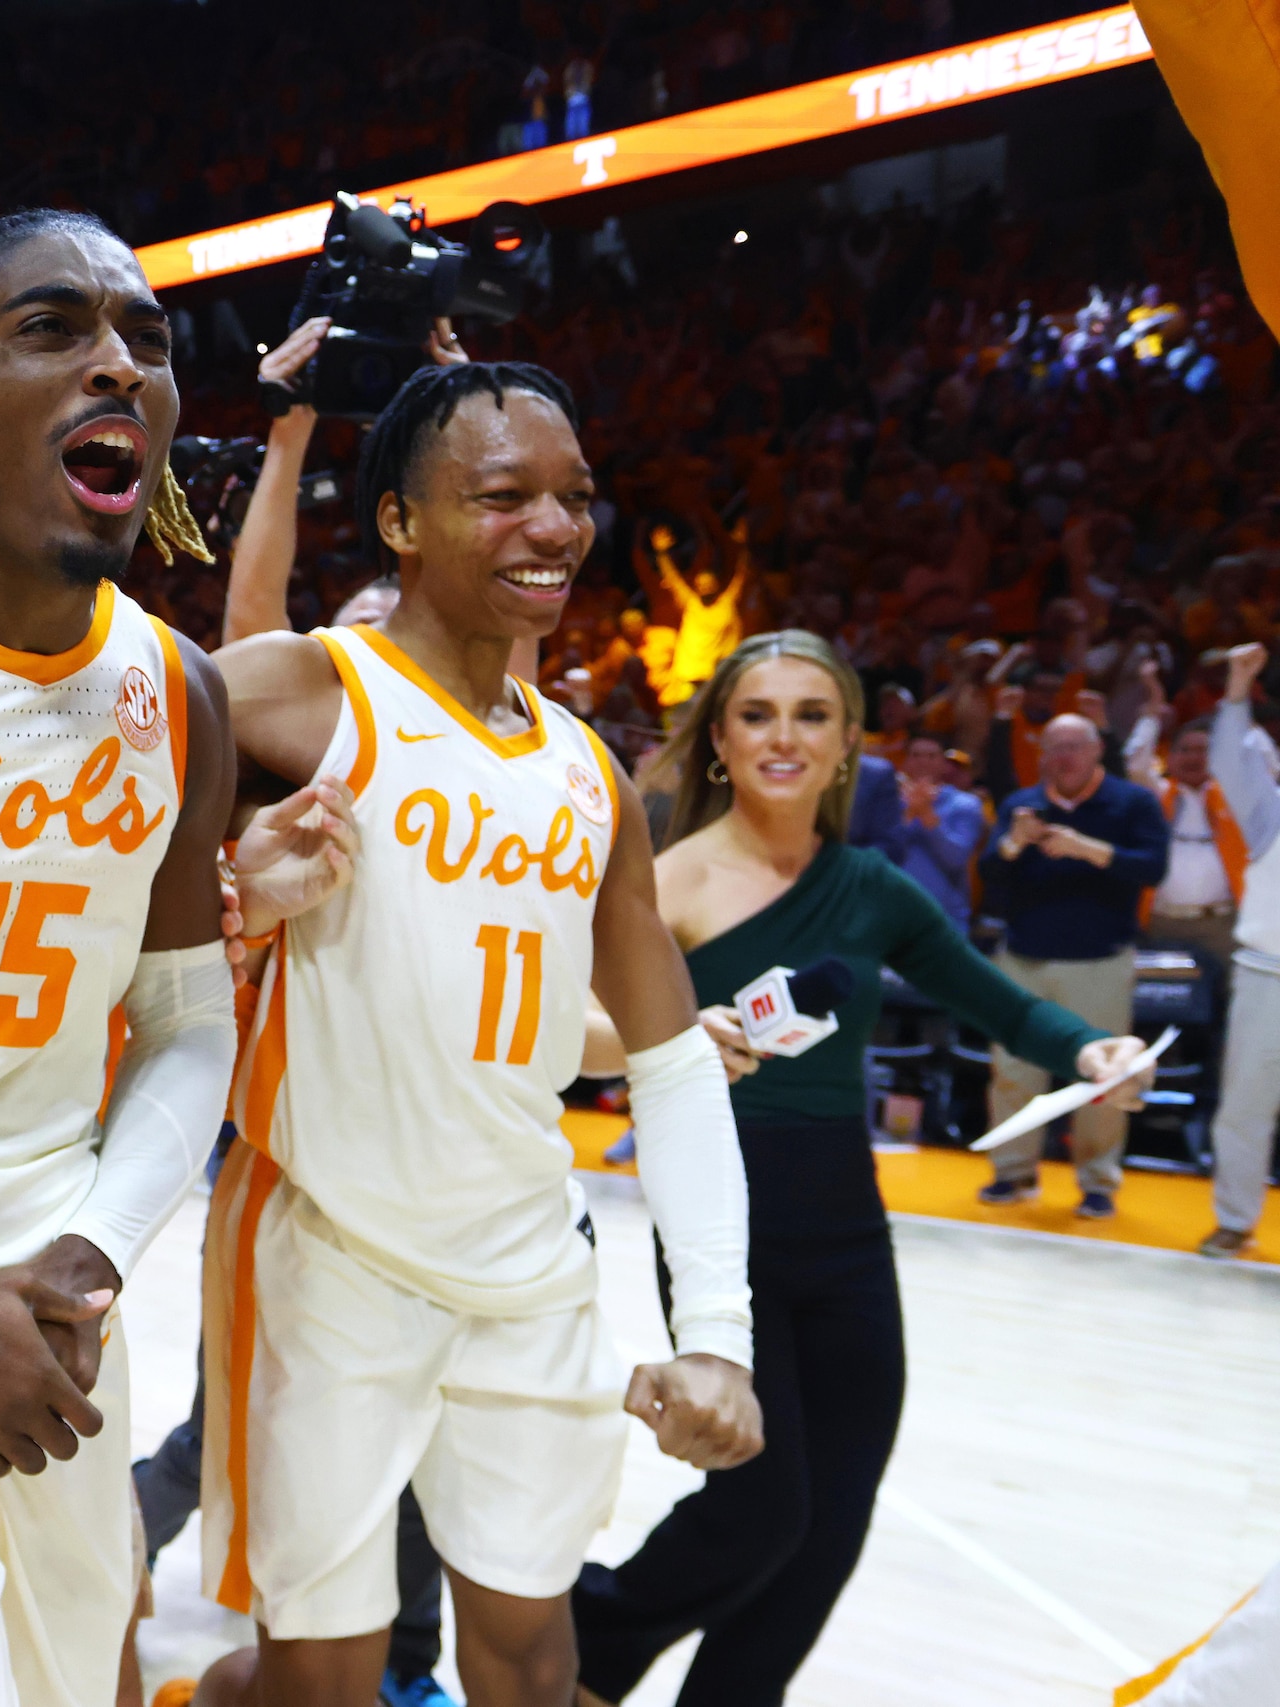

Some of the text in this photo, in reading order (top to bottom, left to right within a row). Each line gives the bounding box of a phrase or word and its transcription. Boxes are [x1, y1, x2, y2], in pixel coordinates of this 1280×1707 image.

[573, 137, 616, 186] T
[394, 788, 600, 899] Vols
[473, 924, 542, 1065] 11
